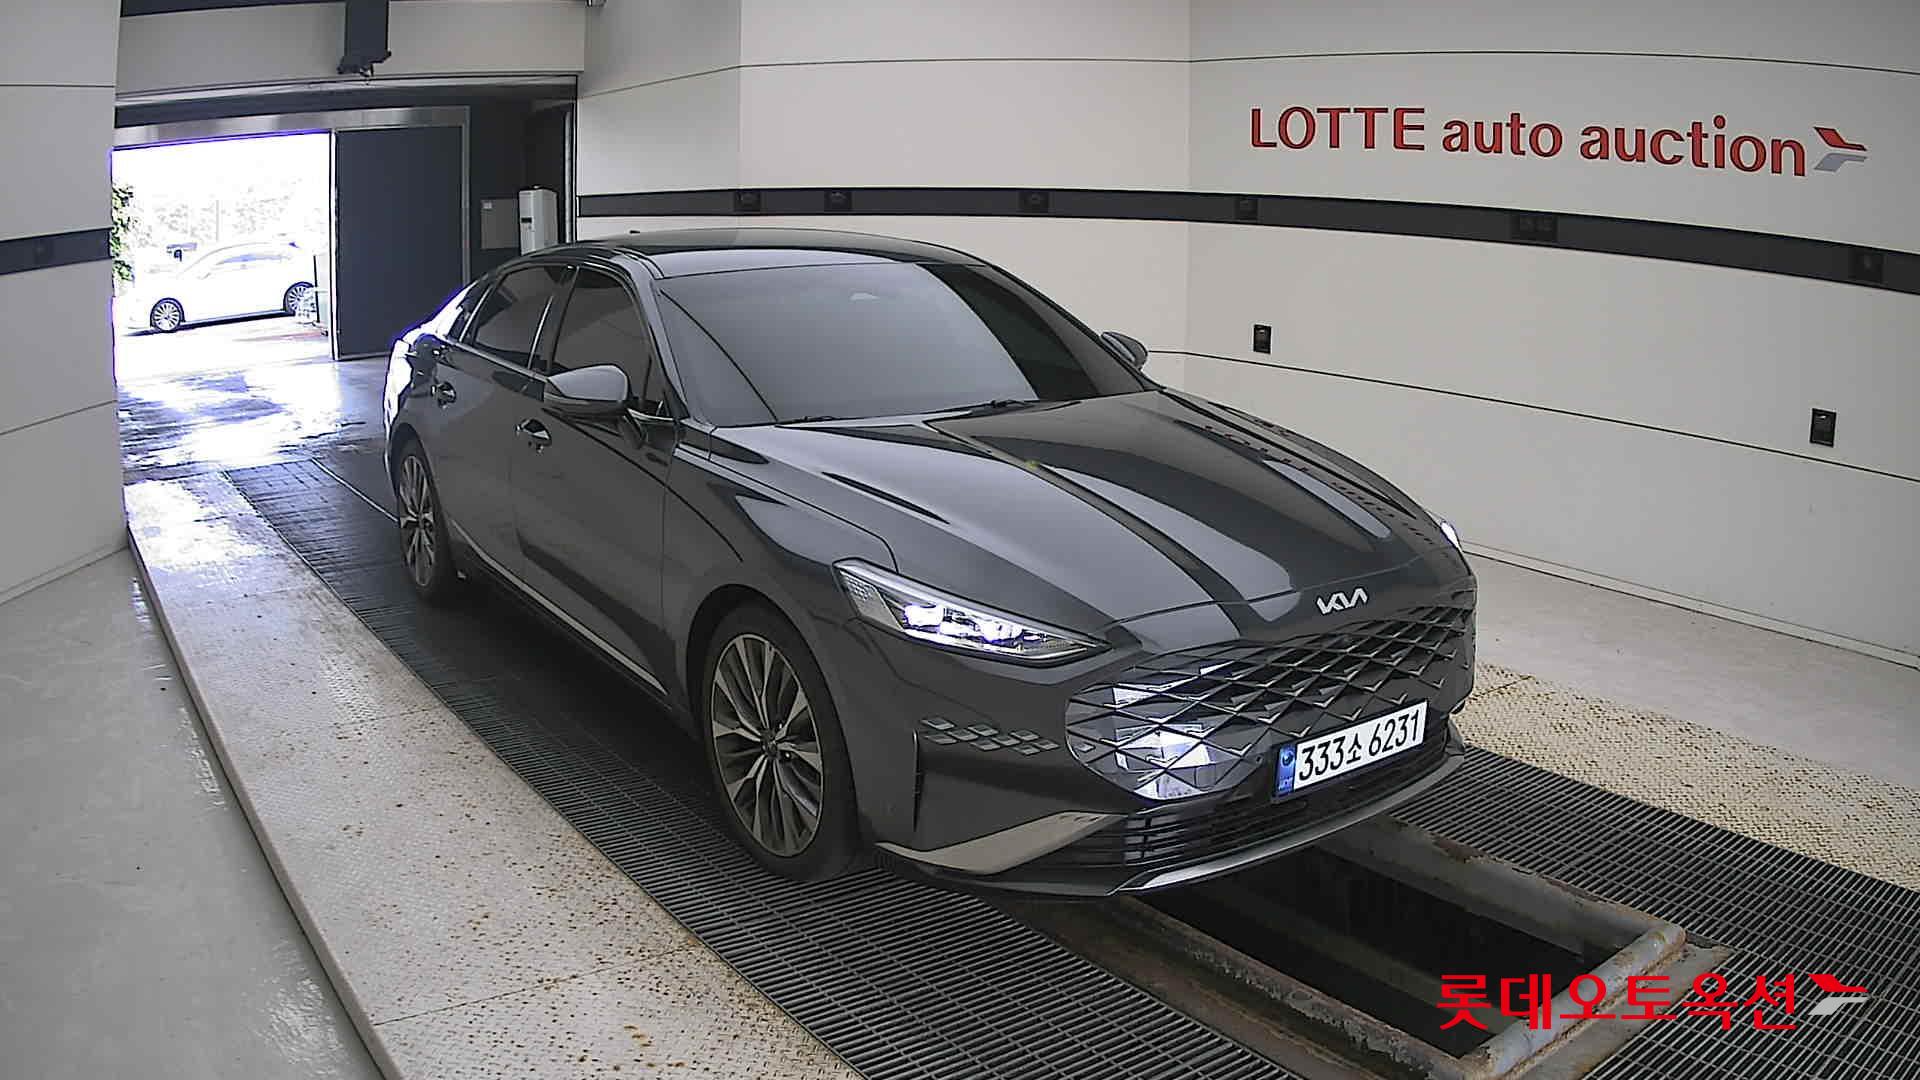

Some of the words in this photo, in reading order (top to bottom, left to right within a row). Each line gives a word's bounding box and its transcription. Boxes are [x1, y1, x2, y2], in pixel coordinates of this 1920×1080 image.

[1249, 106, 1427, 152] LOTTE
[1442, 112, 1564, 158] auto
[1580, 114, 1807, 177] auction
[1298, 732, 1362, 781] 333소
[1368, 709, 1420, 757] 6231
